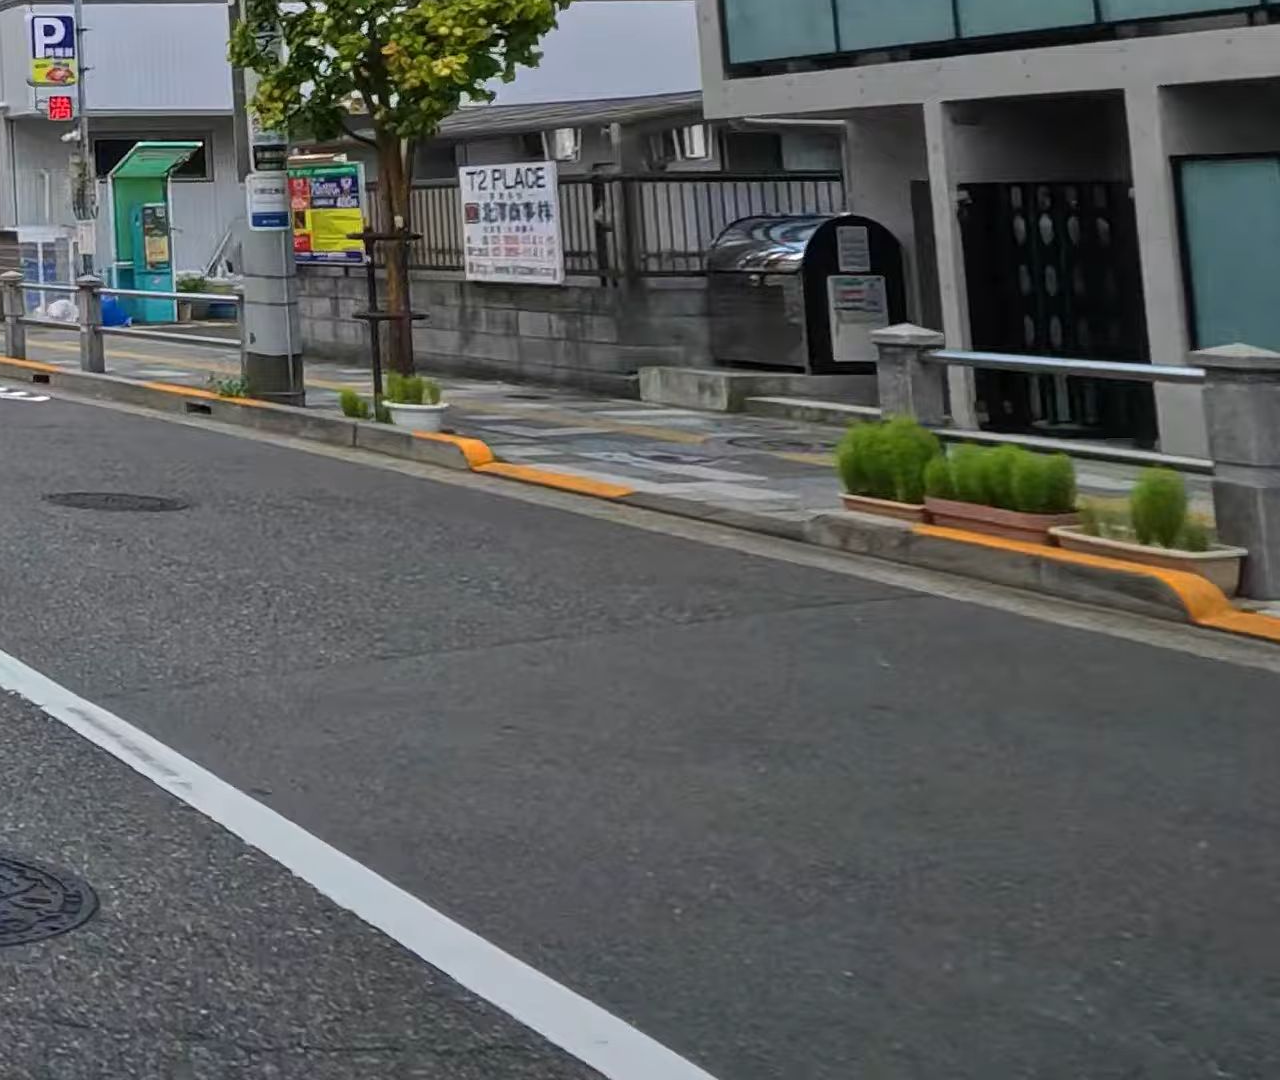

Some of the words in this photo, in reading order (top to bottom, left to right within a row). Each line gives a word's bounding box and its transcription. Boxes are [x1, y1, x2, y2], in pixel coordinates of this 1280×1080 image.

[34, 18, 65, 58] P
[49, 96, 72, 120] 満
[465, 169, 488, 191] T2
[491, 166, 547, 190] PLACE
